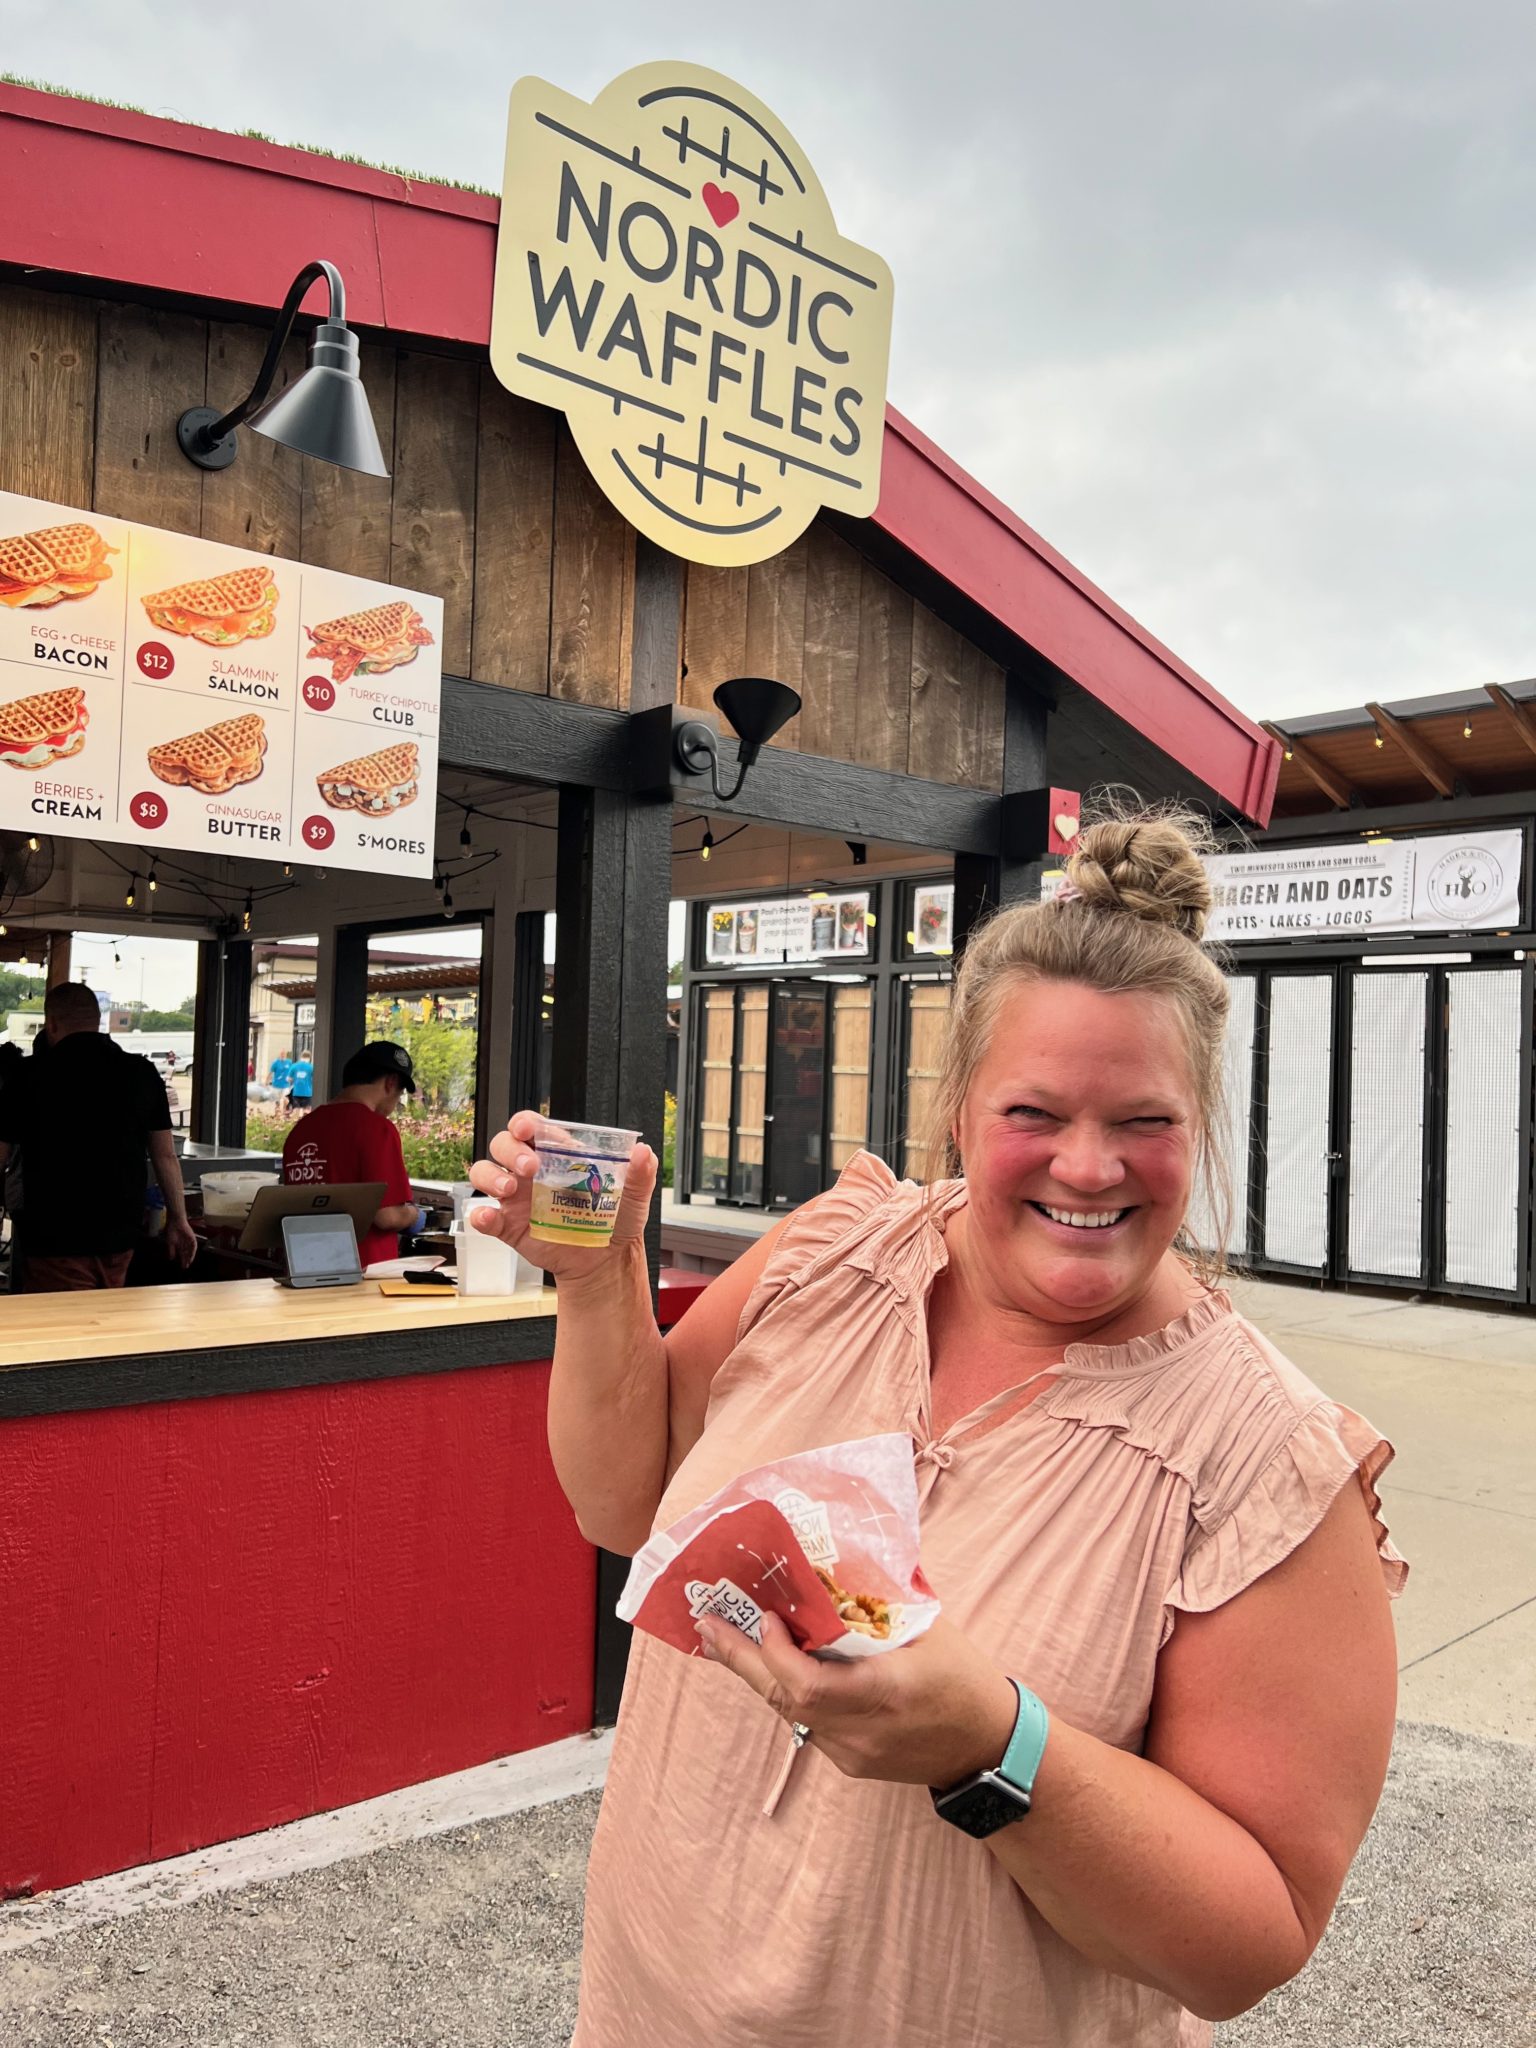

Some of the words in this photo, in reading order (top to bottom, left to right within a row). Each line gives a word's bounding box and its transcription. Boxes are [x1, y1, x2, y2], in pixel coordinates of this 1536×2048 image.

[556, 161, 854, 365] NORDIC
[527, 250, 864, 457] WAFFLES
[30, 625, 59, 641] EGG
[70, 633, 117, 652] CHEESE
[33, 642, 109, 670] BACON
[143, 651, 168, 670] $12
[211, 659, 280, 683] SLAMMIN'
[208, 675, 280, 701] SALMON
[306, 684, 330, 701] $10
[349, 687, 389, 703] TURKEY
[390, 695, 439, 714] CHIPOTLE
[372, 707, 414, 727] CLUB
[34, 780, 94, 801] BERRIES
[31, 798, 102, 821] CREAM
[139, 801, 158, 819] $8
[205, 803, 282, 823] CINNASUGAR
[208, 818, 281, 842] BUTTER
[309, 825, 327, 840] $9
[357, 833, 426, 855] S'MORES
[1247, 863, 1285, 872] MINNESOTA
[1286, 860, 1316, 869] SISTERS
[1317, 859, 1331, 867] AND
[1333, 857, 1352, 866] SOME
[1355, 855, 1377, 864] TOOLS
[1286, 880, 1329, 904] AND
[1337, 875, 1393, 900] OATS
[1227, 915, 1258, 929] PETS
[1269, 913, 1312, 928] LAKES
[1326, 910, 1373, 926] LOGOS
[551, 1190, 591, 1209] Treasure
[599, 1196, 621, 1211] Island
